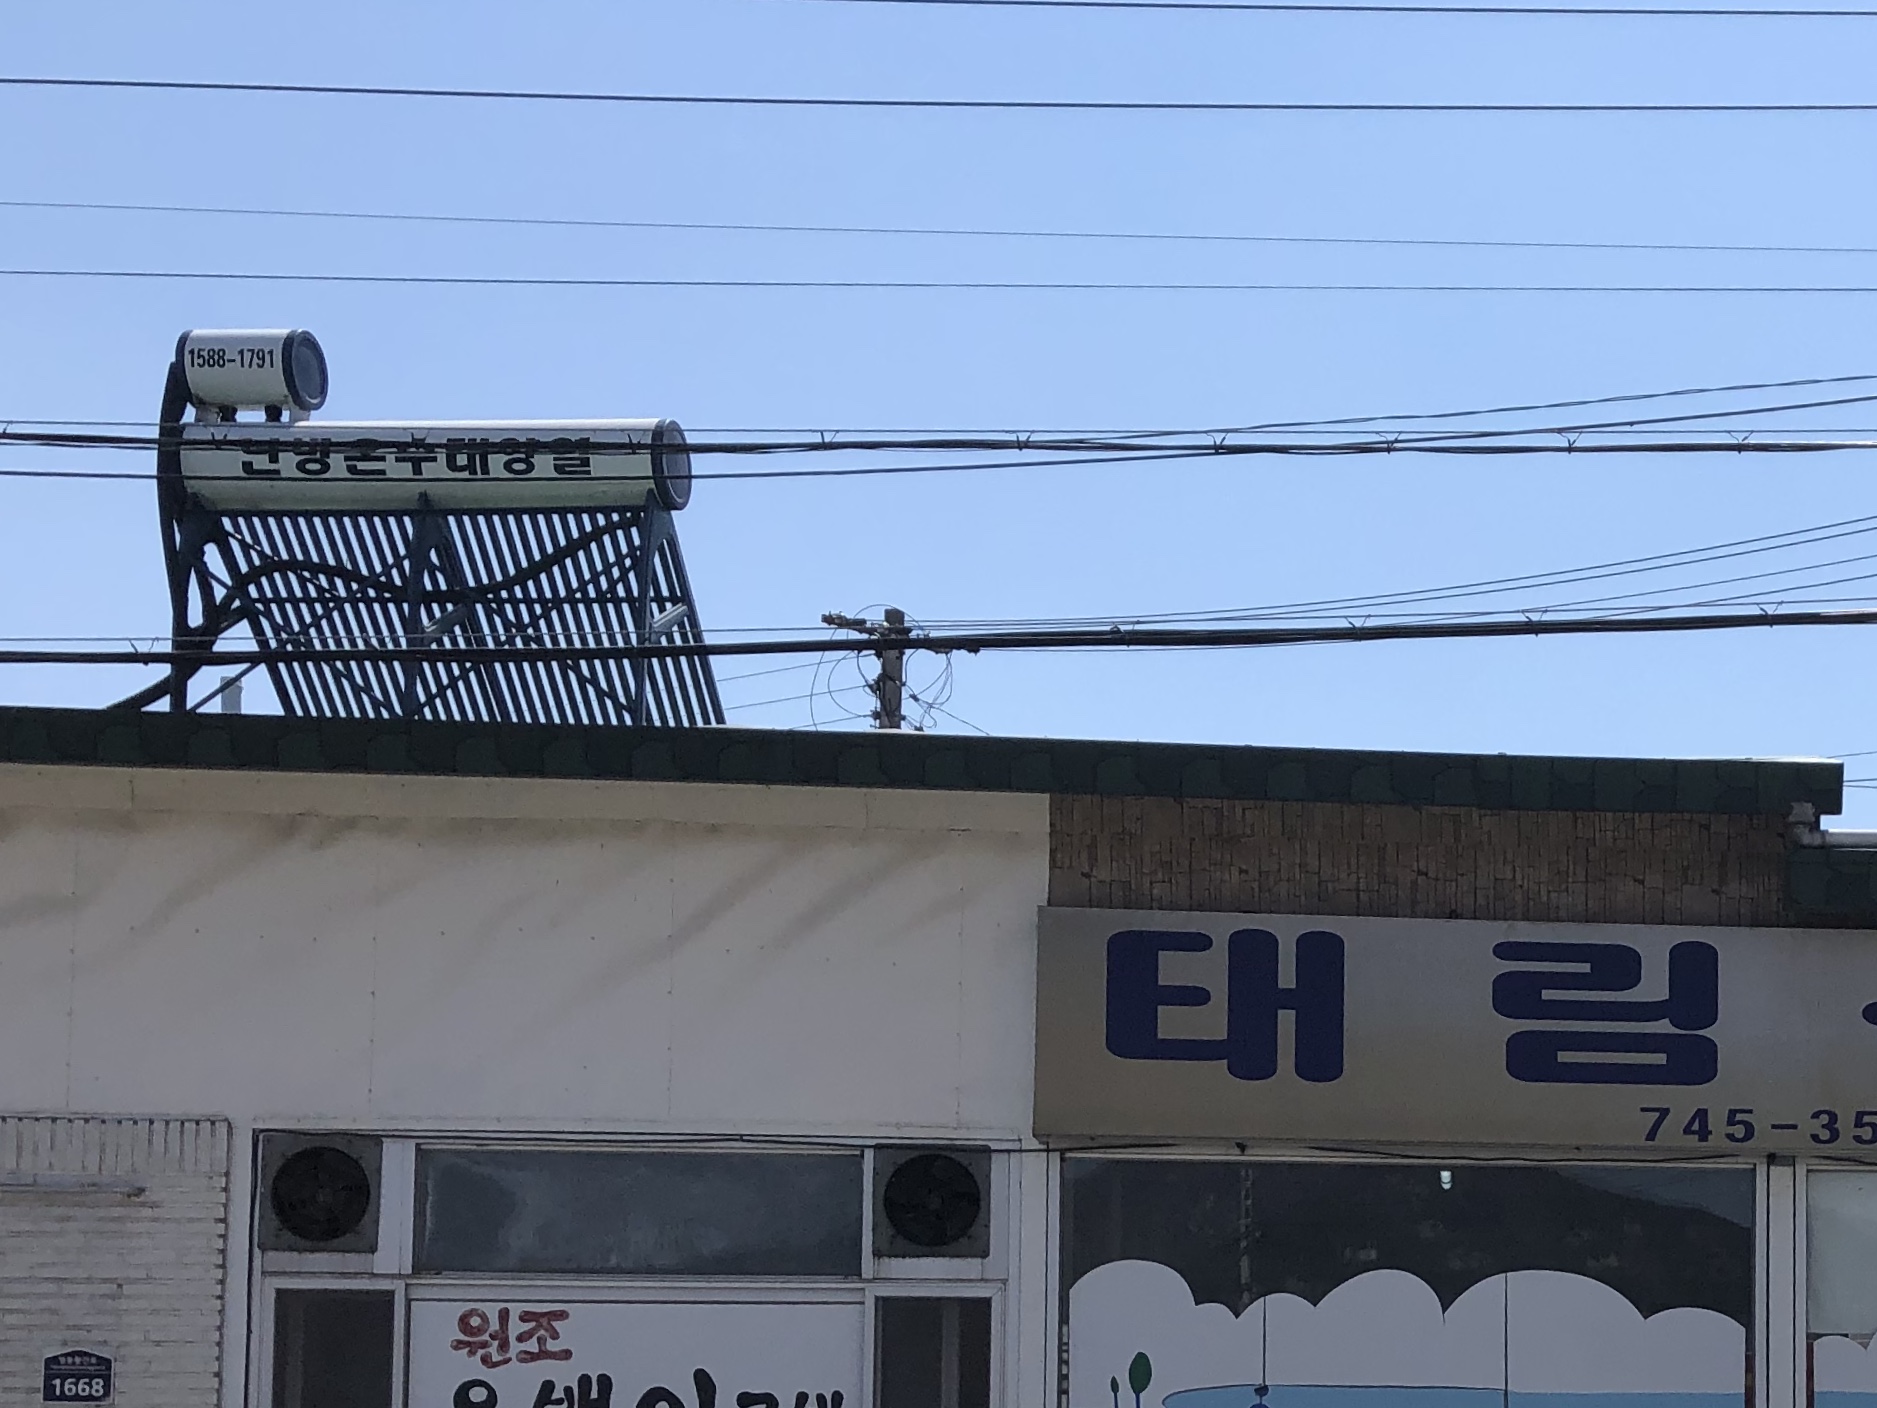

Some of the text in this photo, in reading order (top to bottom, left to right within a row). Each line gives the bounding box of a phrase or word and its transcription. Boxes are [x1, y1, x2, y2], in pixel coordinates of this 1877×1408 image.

[188, 347, 275, 369] 1588-1791
[450, 1307, 573, 1369] 원조
[51, 1378, 104, 1397] 1668
